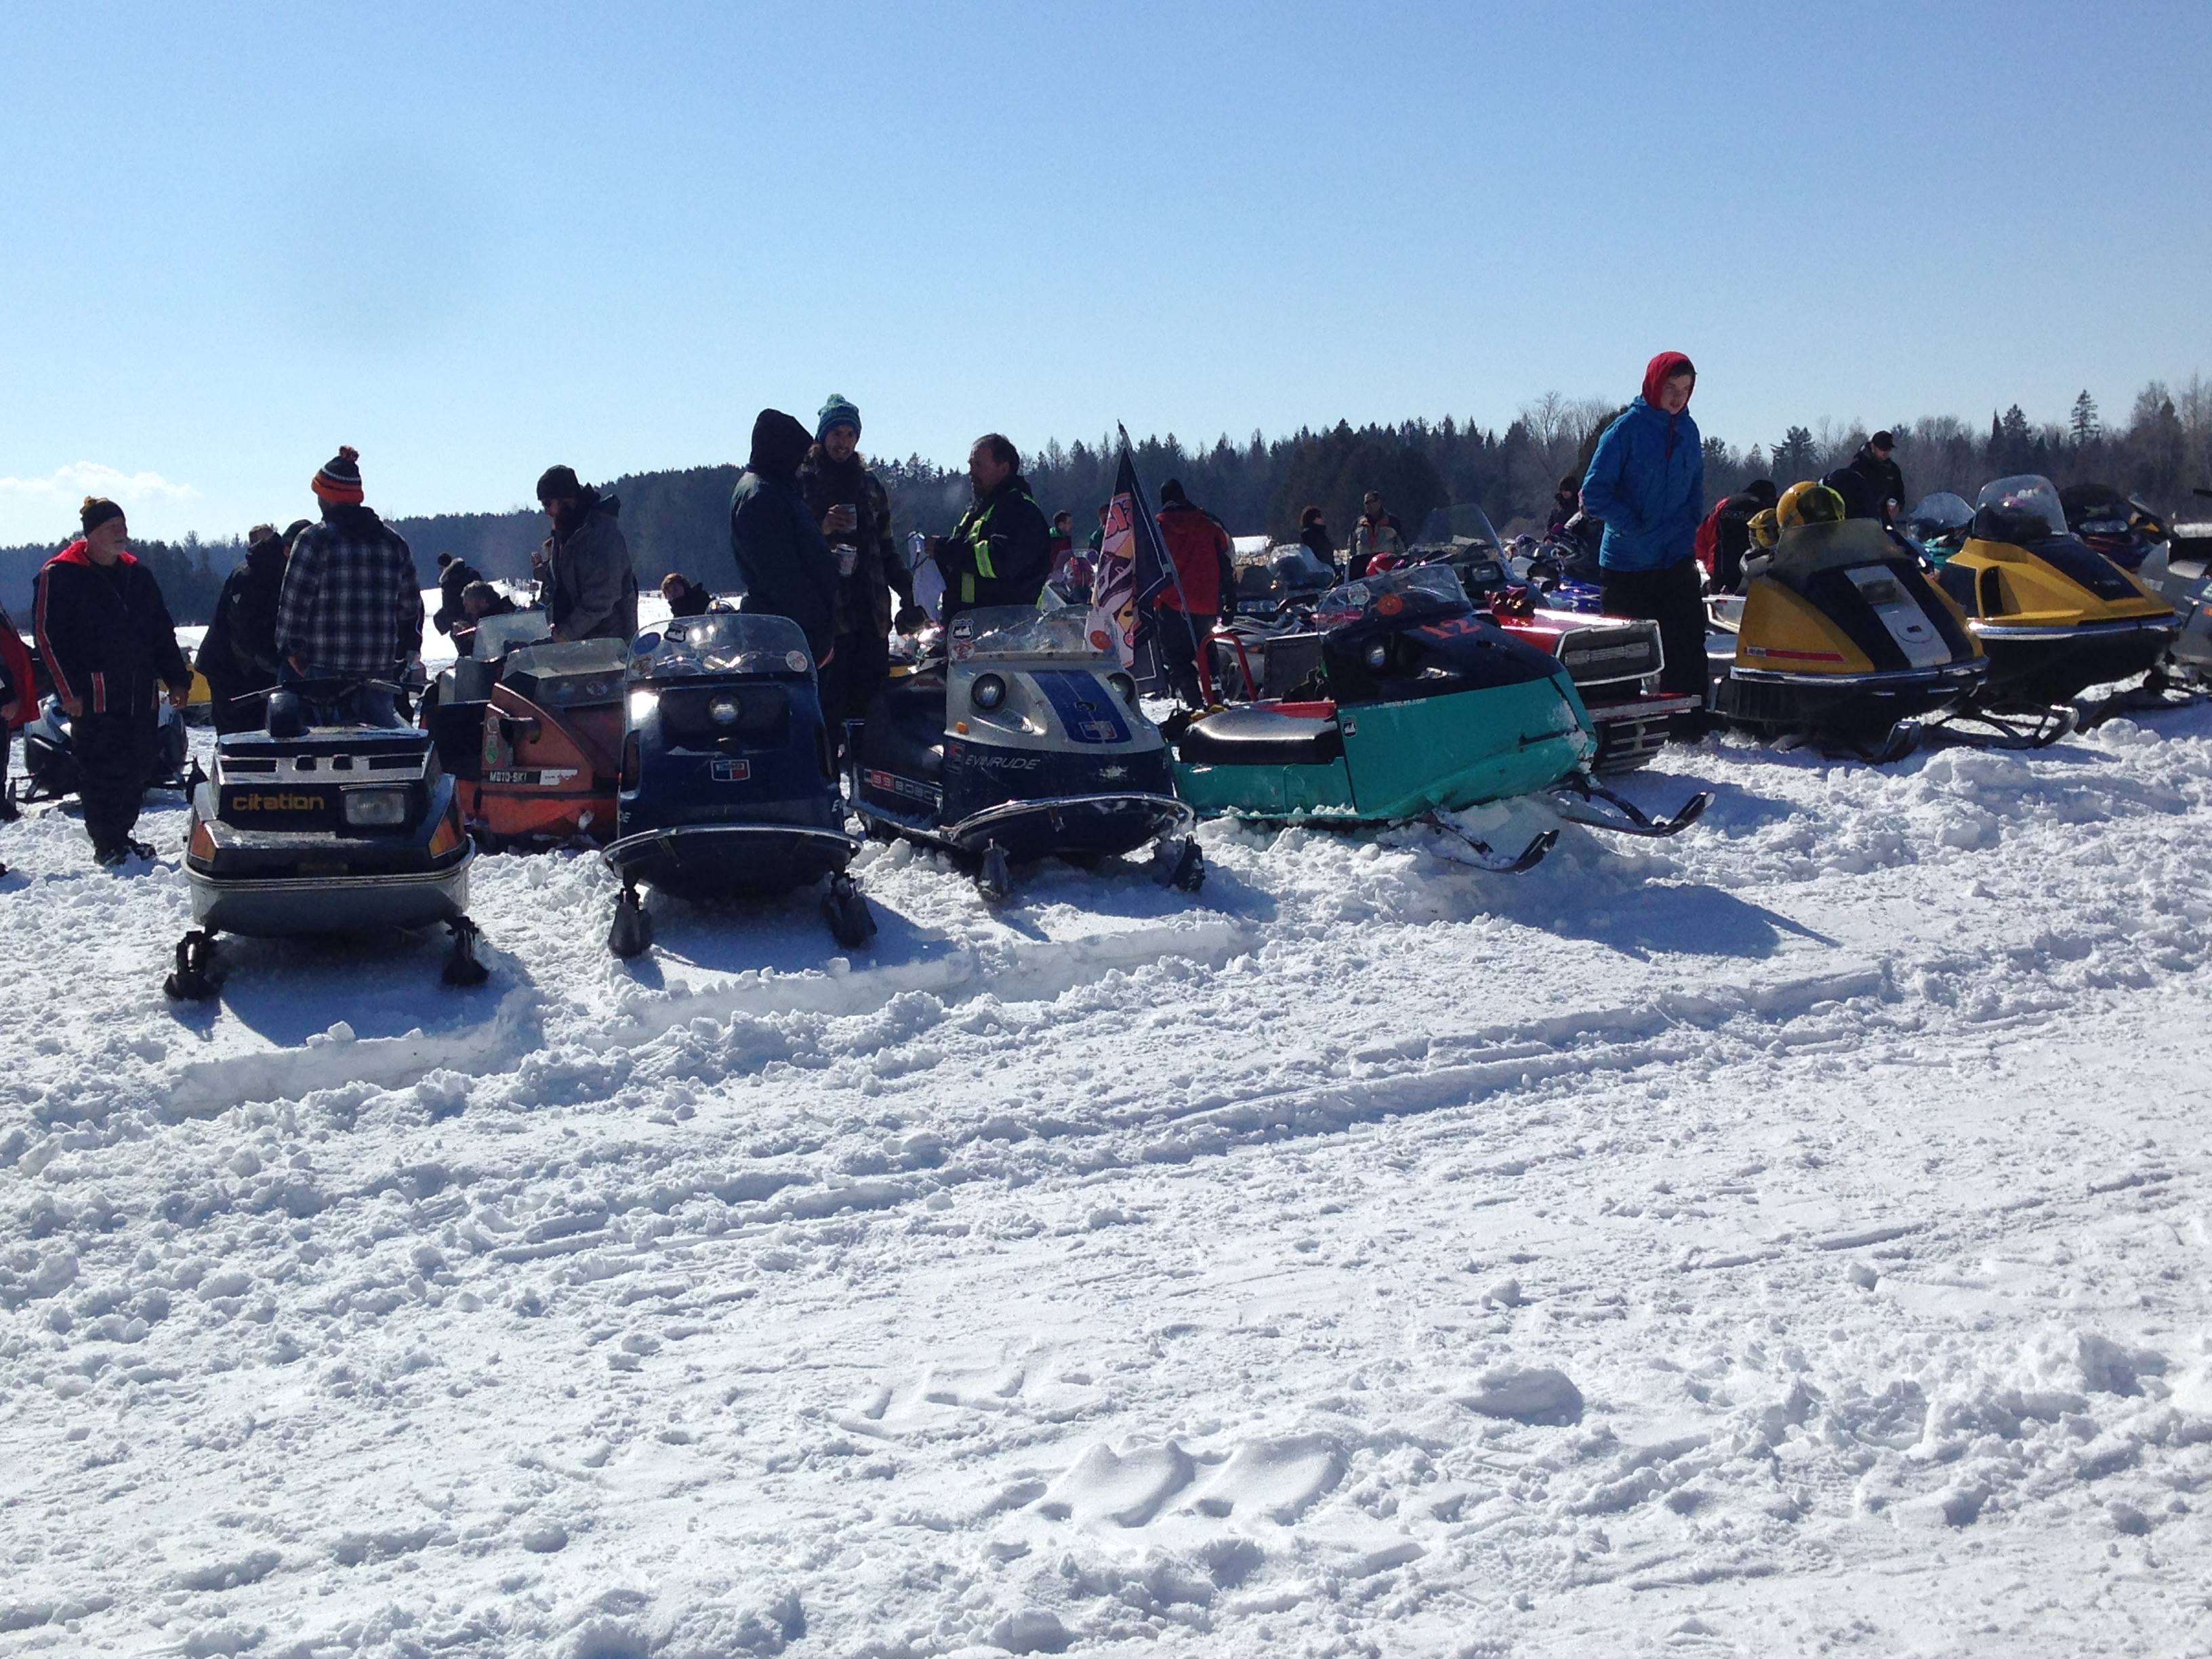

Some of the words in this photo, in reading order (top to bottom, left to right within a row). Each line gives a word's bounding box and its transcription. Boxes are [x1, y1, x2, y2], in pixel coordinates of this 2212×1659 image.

[1420, 619, 1482, 640] 12
[965, 754, 1041, 770] EVINRUDE
[489, 772, 527, 782] MOTO-SKI
[232, 793, 325, 811] citation
